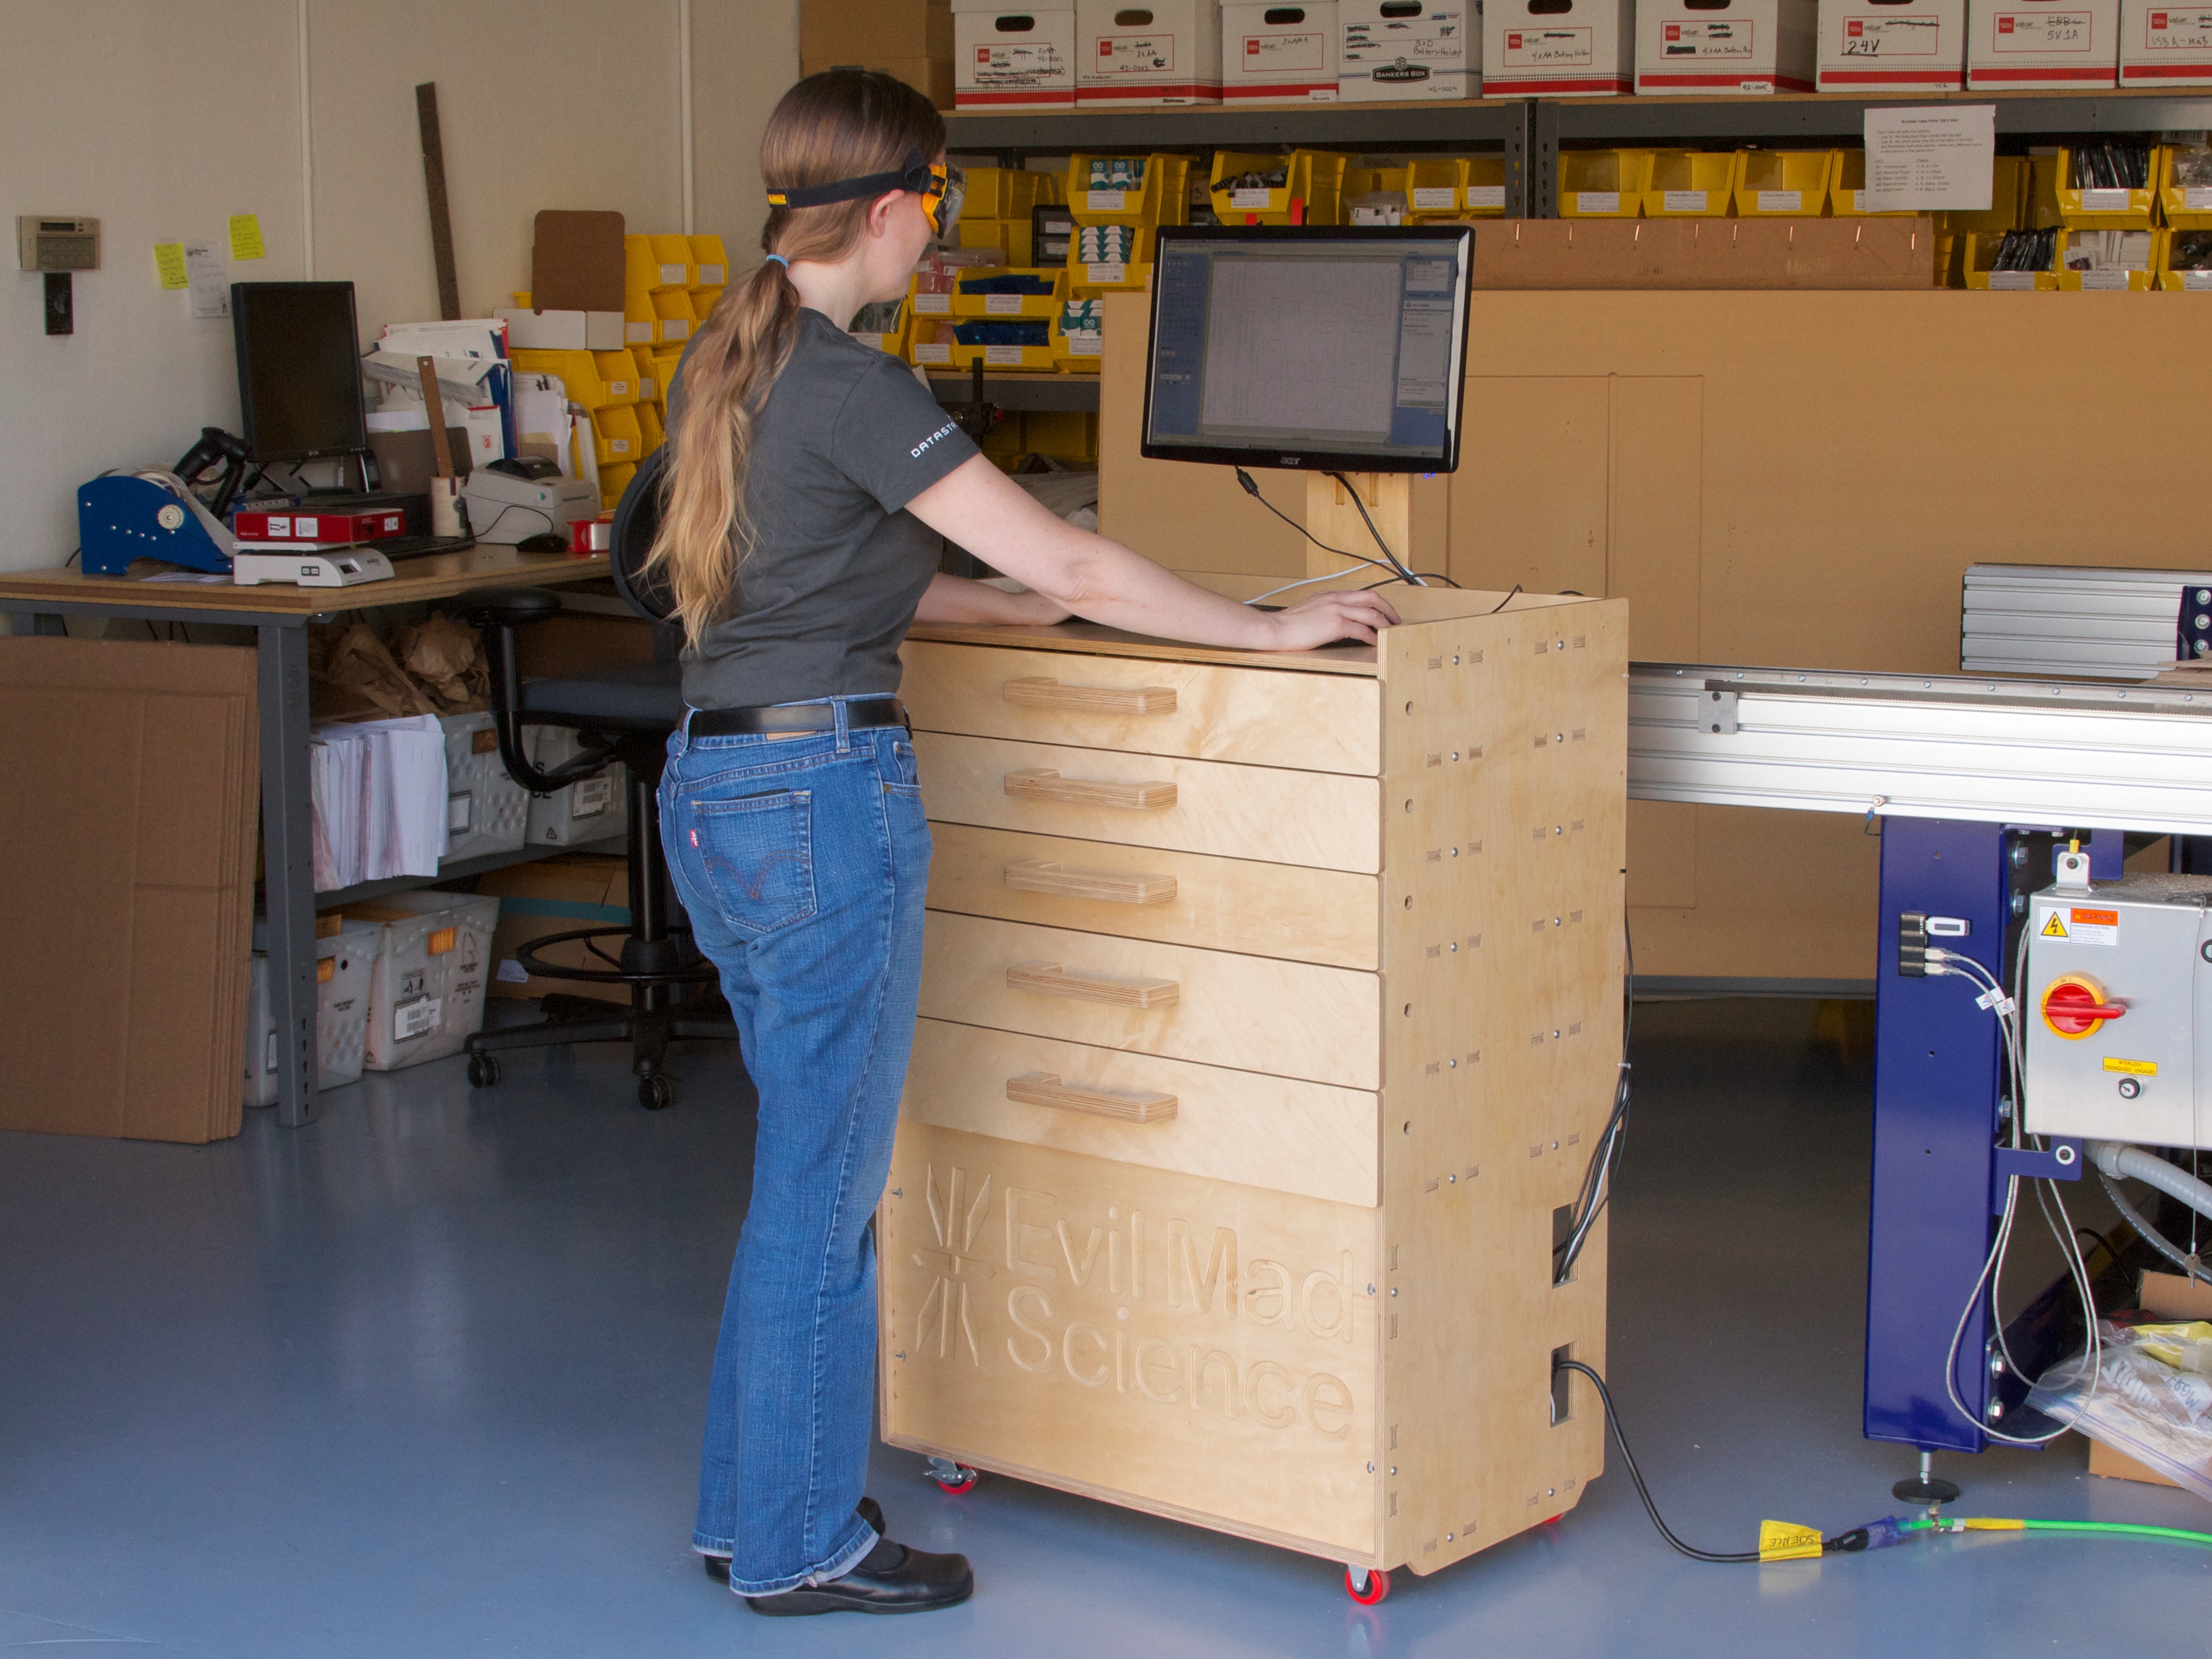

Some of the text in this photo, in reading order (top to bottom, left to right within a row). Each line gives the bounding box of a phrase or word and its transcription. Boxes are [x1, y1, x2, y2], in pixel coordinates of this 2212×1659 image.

[1848, 39, 1880, 54] 24V
[1280, 456, 1301, 465] acer
[2083, 912, 2115, 922] WARNING
[1006, 1185, 1354, 1345] Evil Mad
[1006, 1284, 1354, 1442] Science
